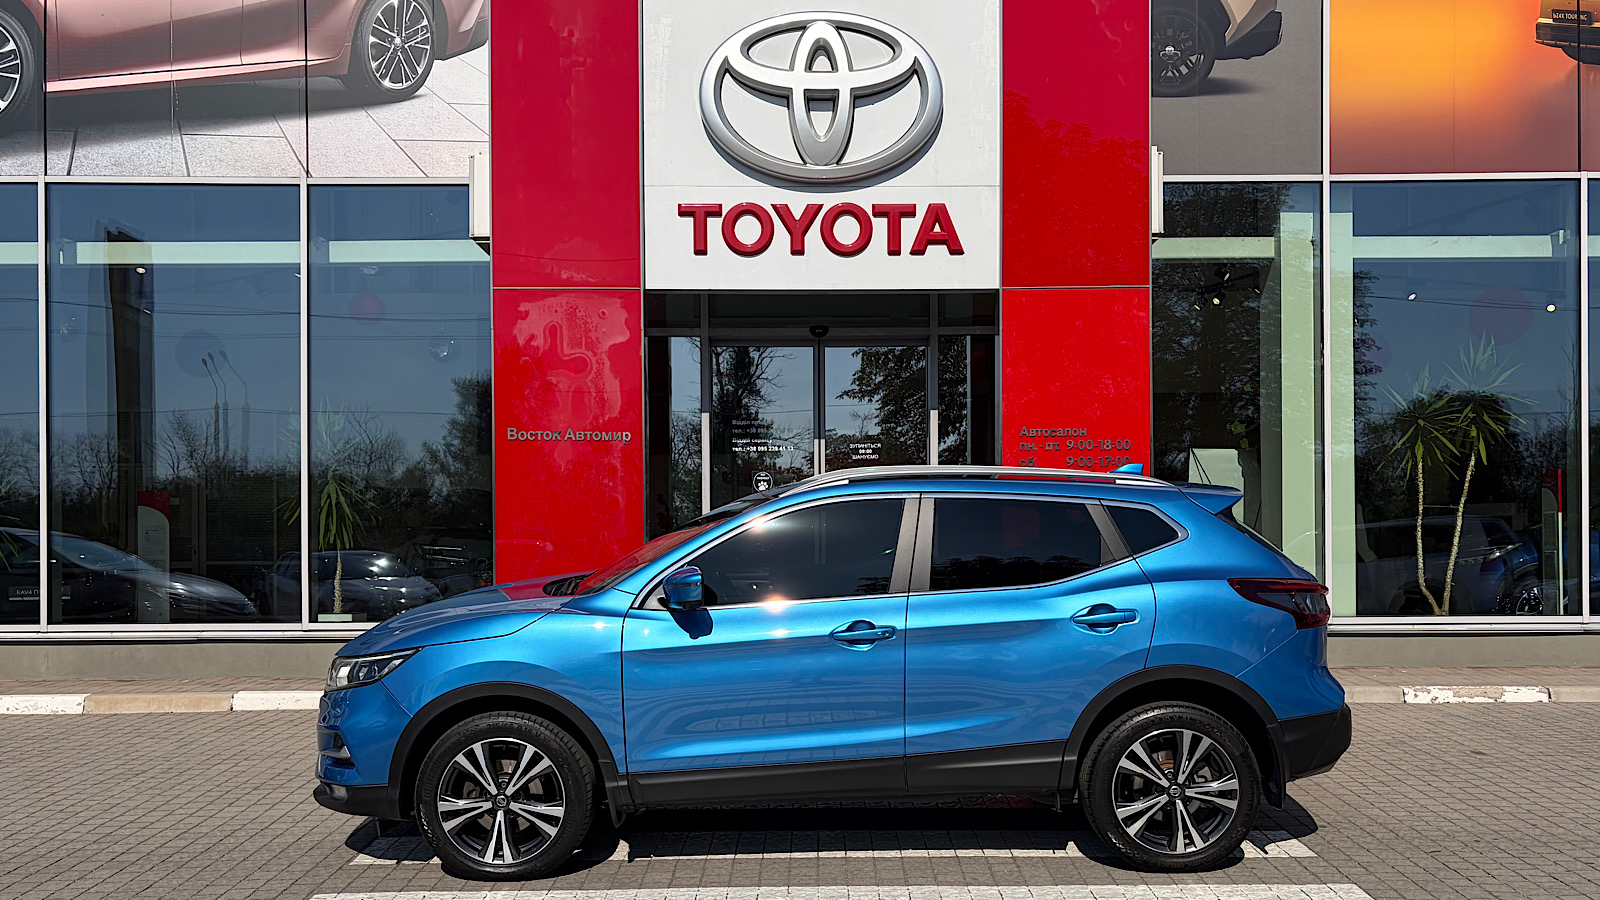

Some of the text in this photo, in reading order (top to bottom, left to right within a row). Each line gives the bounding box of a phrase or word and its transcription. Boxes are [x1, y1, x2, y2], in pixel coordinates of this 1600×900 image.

[678, 202, 965, 257] TOYOTA
[507, 427, 632, 444] Восток Автомир
[1020, 426, 1087, 437] Автосалон
[1066, 440, 1131, 451] 9:00-18:00
[1020, 456, 1131, 467] сб. 9:00-17:00
